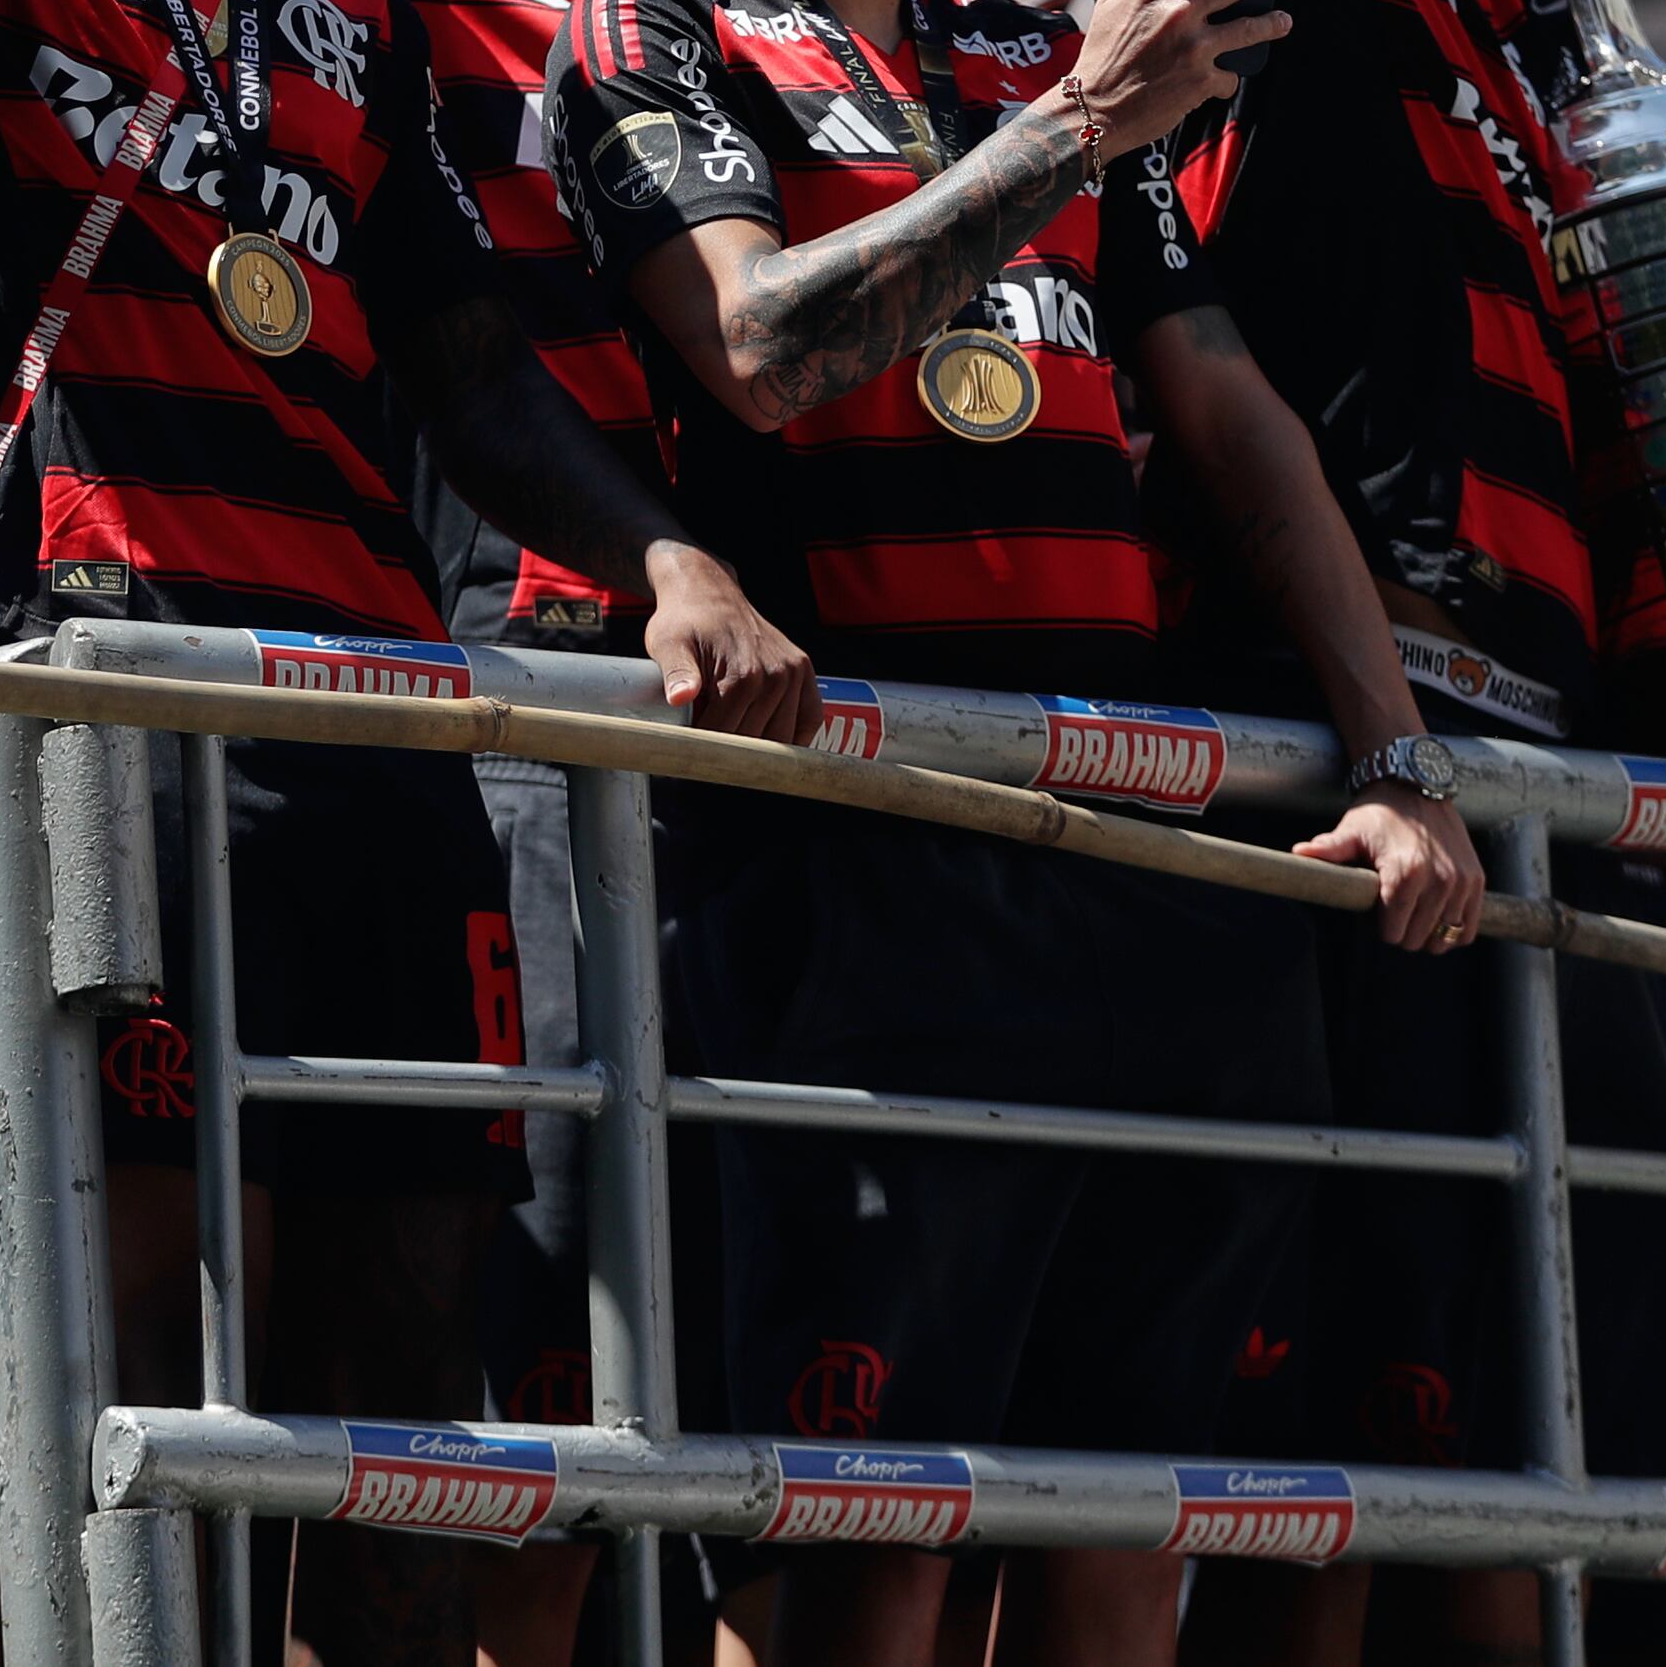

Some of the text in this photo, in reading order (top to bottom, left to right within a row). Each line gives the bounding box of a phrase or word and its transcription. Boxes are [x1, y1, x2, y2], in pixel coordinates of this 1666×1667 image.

[238, 6, 262, 131] CONMEBOL
[114, 90, 176, 171] BRAHMA
[1137, 137, 1189, 270] opee
[62, 194, 124, 279] BRAHMA
[13, 305, 71, 393] BRAHMA
[1049, 726, 1211, 796] BRAHMA
[410, 1434, 506, 1461] Chopp
[835, 1454, 925, 1480] Chopp
[345, 1470, 537, 1529] BRAHMA
[1227, 1471, 1307, 1498] Chopp
[778, 1494, 956, 1542] BRAHMA
[1176, 1511, 1341, 1559] BRAHMA
